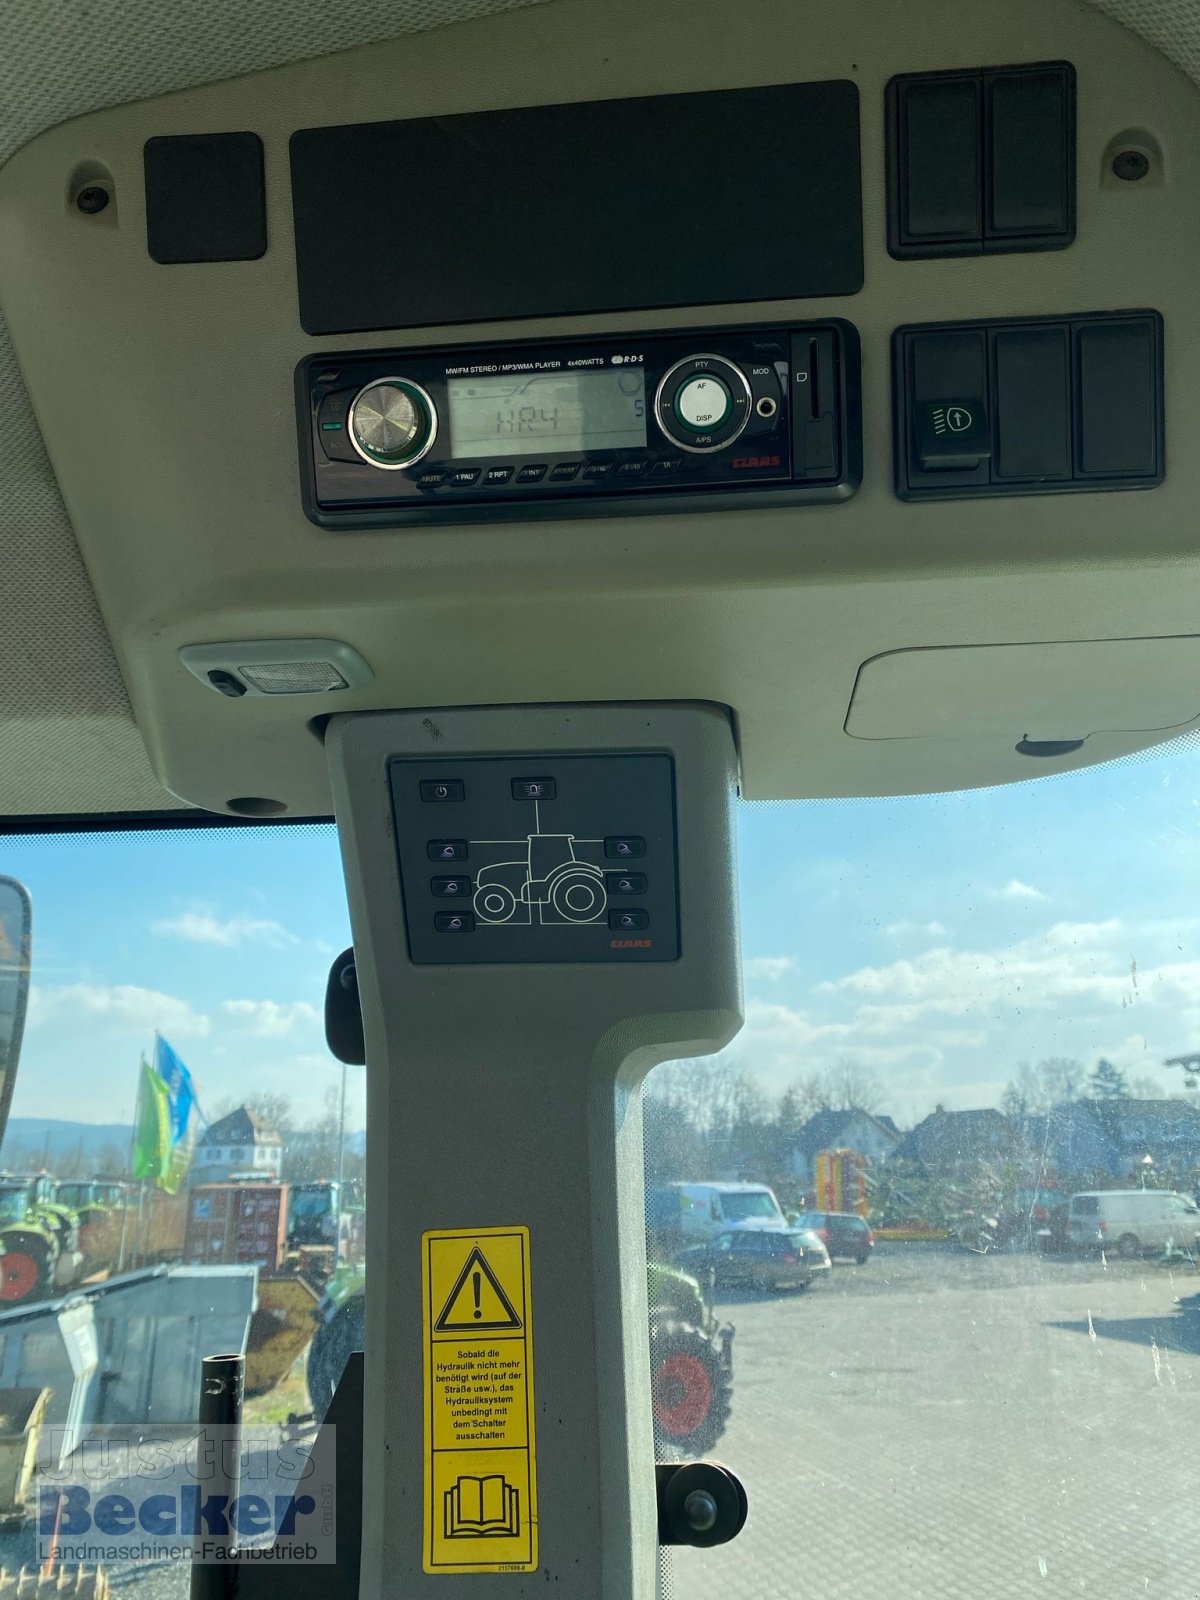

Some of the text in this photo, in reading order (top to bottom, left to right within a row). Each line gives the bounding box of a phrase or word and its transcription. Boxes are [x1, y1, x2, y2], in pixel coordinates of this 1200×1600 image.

[445, 367, 469, 375] MW/FM
[470, 365, 498, 373] STEREO
[502, 363, 534, 371] MP3/WMA
[535, 361, 561, 369] PLAYER
[567, 358, 604, 366] 4x40WATTS
[732, 456, 781, 468] CLAAS
[610, 939, 652, 948] CLAAS
[458, 1350, 485, 1358] Sobald
[437, 1362, 475, 1372] Hydraulik
[477, 1361, 497, 1369] nicht
[436, 1374, 469, 1382] benötigt
[471, 1373, 488, 1381] wird
[490, 1373, 506, 1381] (auf
[444, 1385, 471, 1393] Straße
[499, 1384, 514, 1392] das
[445, 1396, 513, 1406] Hydrauliksystem
[452, 1409, 492, 1417] unbedingt
[453, 1419, 506, 1428] dem Schalter
[456, 1431, 505, 1440] ausschalten
